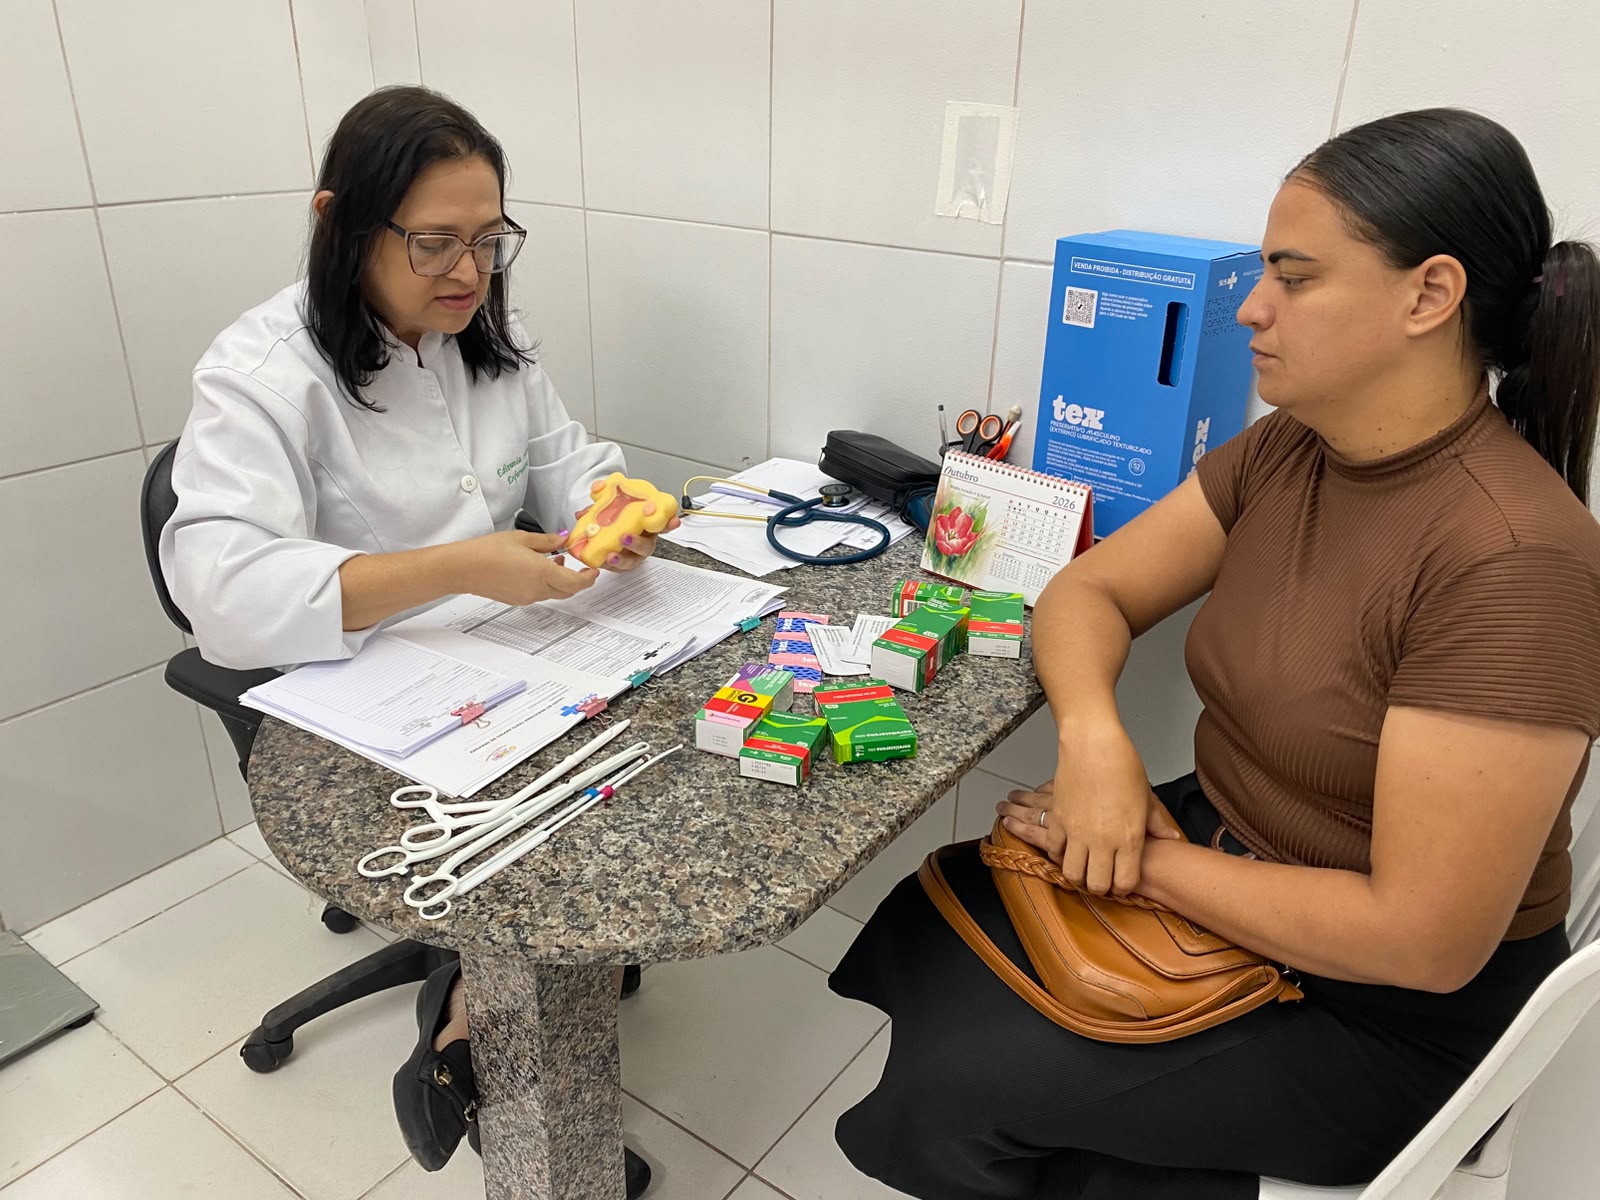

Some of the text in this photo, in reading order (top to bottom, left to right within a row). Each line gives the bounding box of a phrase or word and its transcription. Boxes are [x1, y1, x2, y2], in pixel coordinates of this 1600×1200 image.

[1073, 261, 1092, 271] VENDA
[1093, 264, 1119, 274] PROIBIDA
[1123, 268, 1162, 281] DISTRIBUIÇÃO
[1163, 273, 1192, 285] GRATUITA
[1052, 395, 1104, 430] tex
[1049, 426, 1076, 439] (EXTERNO)
[1077, 432, 1111, 446] LUBRIFICADO
[1112, 441, 1152, 455] TEXTURIZADO
[1050, 420, 1120, 441] PRESERVATIVO MASCULINO
[944, 465, 979, 483] Outubro
[1052, 496, 1076, 510] 2026
[737, 693, 758, 703] G
